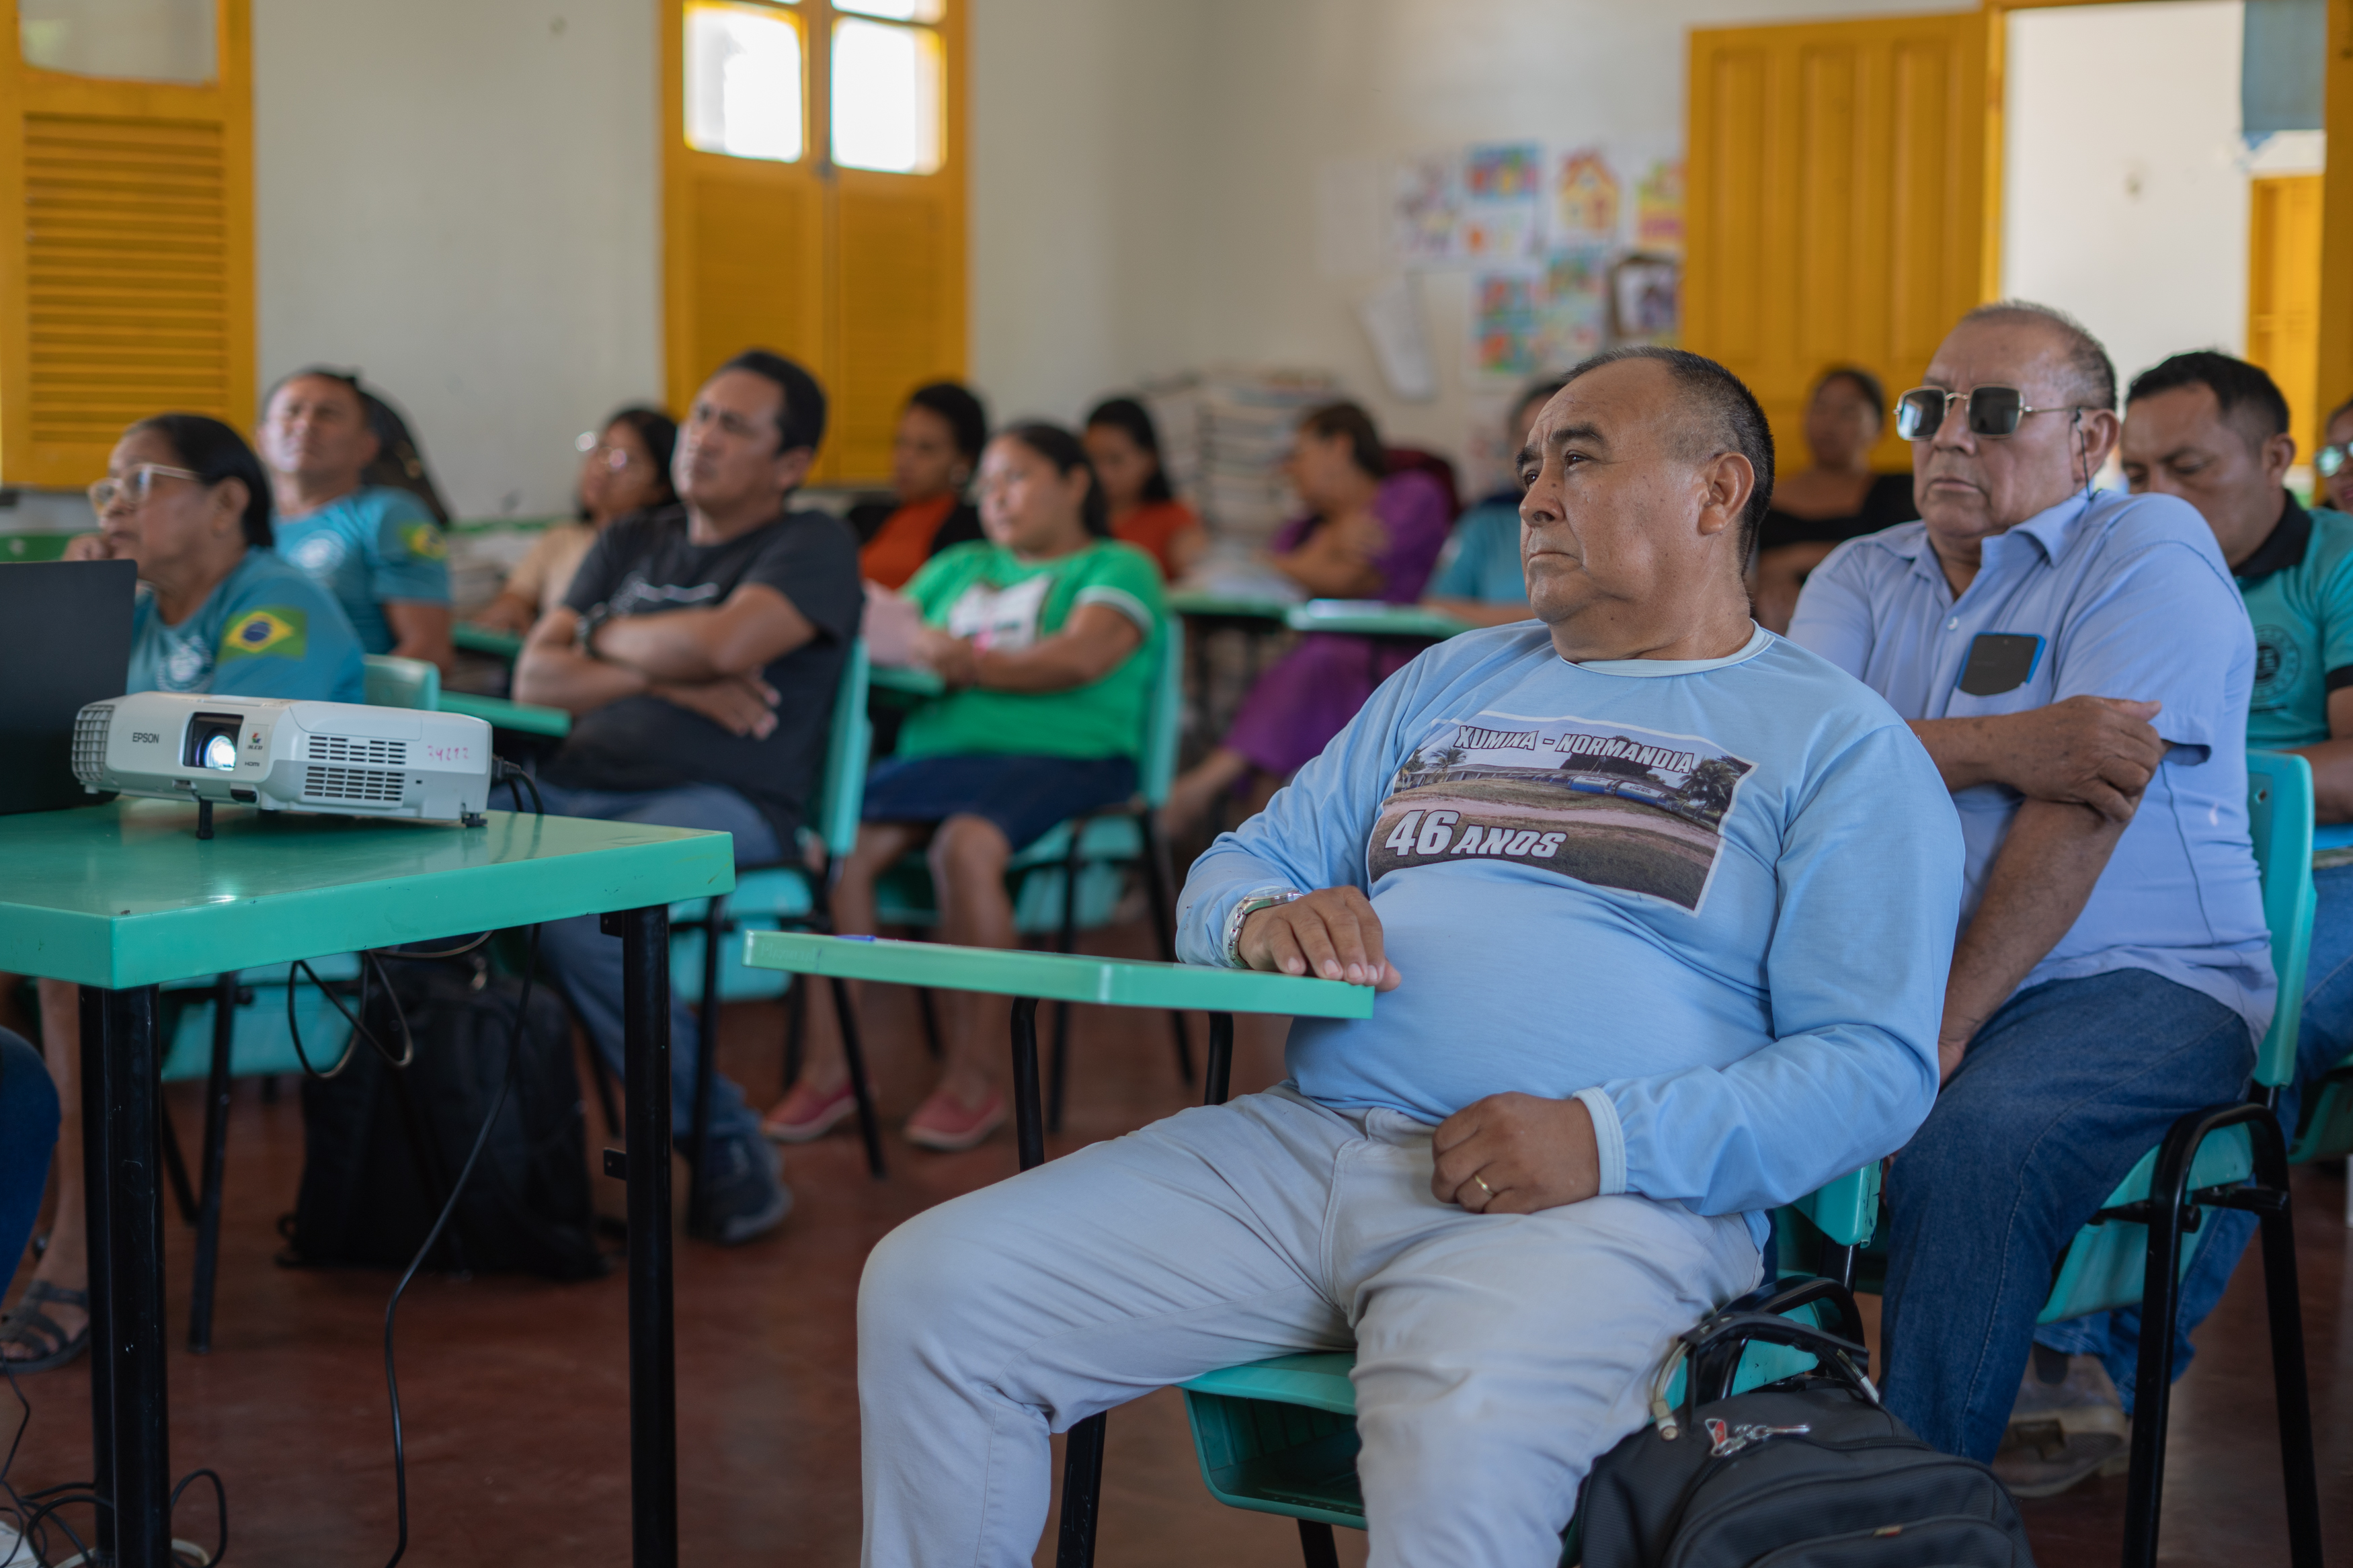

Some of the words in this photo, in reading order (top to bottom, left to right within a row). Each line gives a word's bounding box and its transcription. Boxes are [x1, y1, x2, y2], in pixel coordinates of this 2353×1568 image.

[132, 732, 159, 743] EPSON
[1453, 725, 1540, 751] XUMINA
[1554, 733, 1694, 774] NORMANDIA
[1384, 809, 1460, 856] 46
[1450, 824, 1568, 858] ANOS
